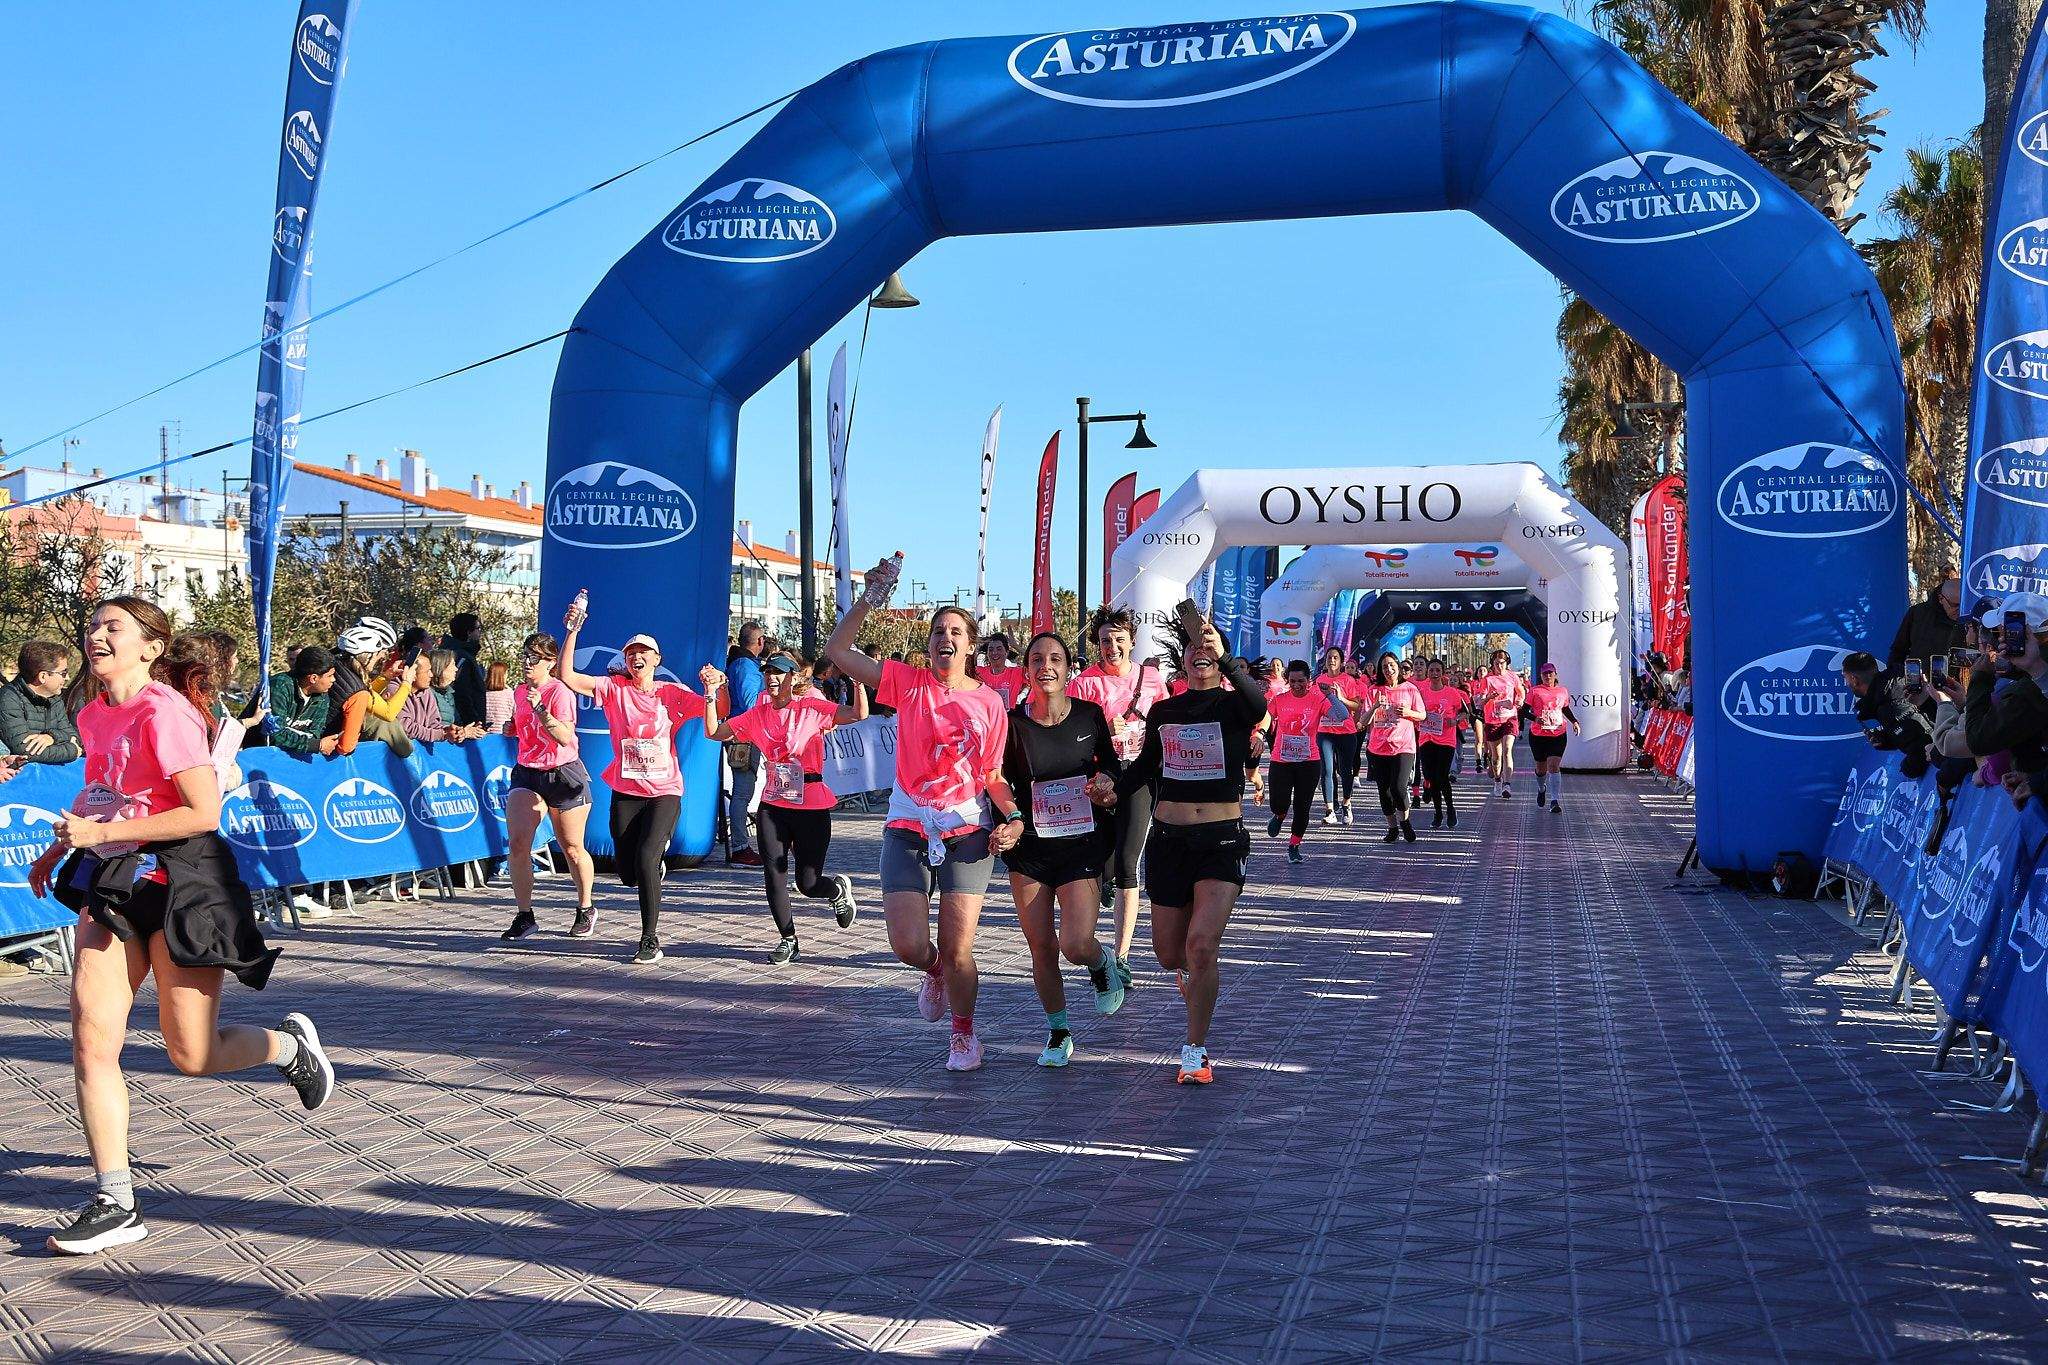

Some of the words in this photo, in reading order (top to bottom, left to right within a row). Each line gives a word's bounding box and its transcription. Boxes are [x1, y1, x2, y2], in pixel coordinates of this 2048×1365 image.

[1092, 24, 1197, 42] CENTRAL
[1209, 14, 1319, 30] LECHERA
[1030, 23, 1328, 79] ASTURIANA
[1596, 182, 1665, 197] CENTRAL
[1671, 178, 1736, 189] LECHERA
[700, 206, 752, 217] CENTRAL
[757, 205, 817, 215] LECHERA
[1567, 190, 1748, 226] ASTURIANA
[670, 214, 823, 242] ASTURIANA
[1757, 476, 1824, 487] CENTRAL
[1830, 474, 1886, 484] LECHERA
[566, 491, 616, 500] CENTRAL
[621, 492, 680, 504] LECHERA
[1259, 482, 1462, 525] OYSHO
[1728, 481, 1891, 517] ASTURIANA
[550, 494, 685, 530] ASTURIANA
[1142, 533, 1201, 545] OYSHO
[1522, 524, 1585, 539] OYSHO
[1661, 503, 1678, 594] Santander
[1365, 571, 1409, 579] TotalEnergies
[1214, 569, 1241, 632] Marlene
[1240, 576, 1261, 634] Marlene
[1406, 601, 1506, 611] VOLVO
[1558, 610, 1617, 624] OYSHO
[1761, 678, 1828, 688] CENTRAL
[1570, 694, 1617, 707] YSHO
[1180, 749, 1204, 759] 016
[332, 803, 402, 828] ASTURIANA
[420, 796, 476, 820] ASTURIANA
[1048, 803, 1072, 815] 016
[228, 807, 313, 834] ASTURIANA
